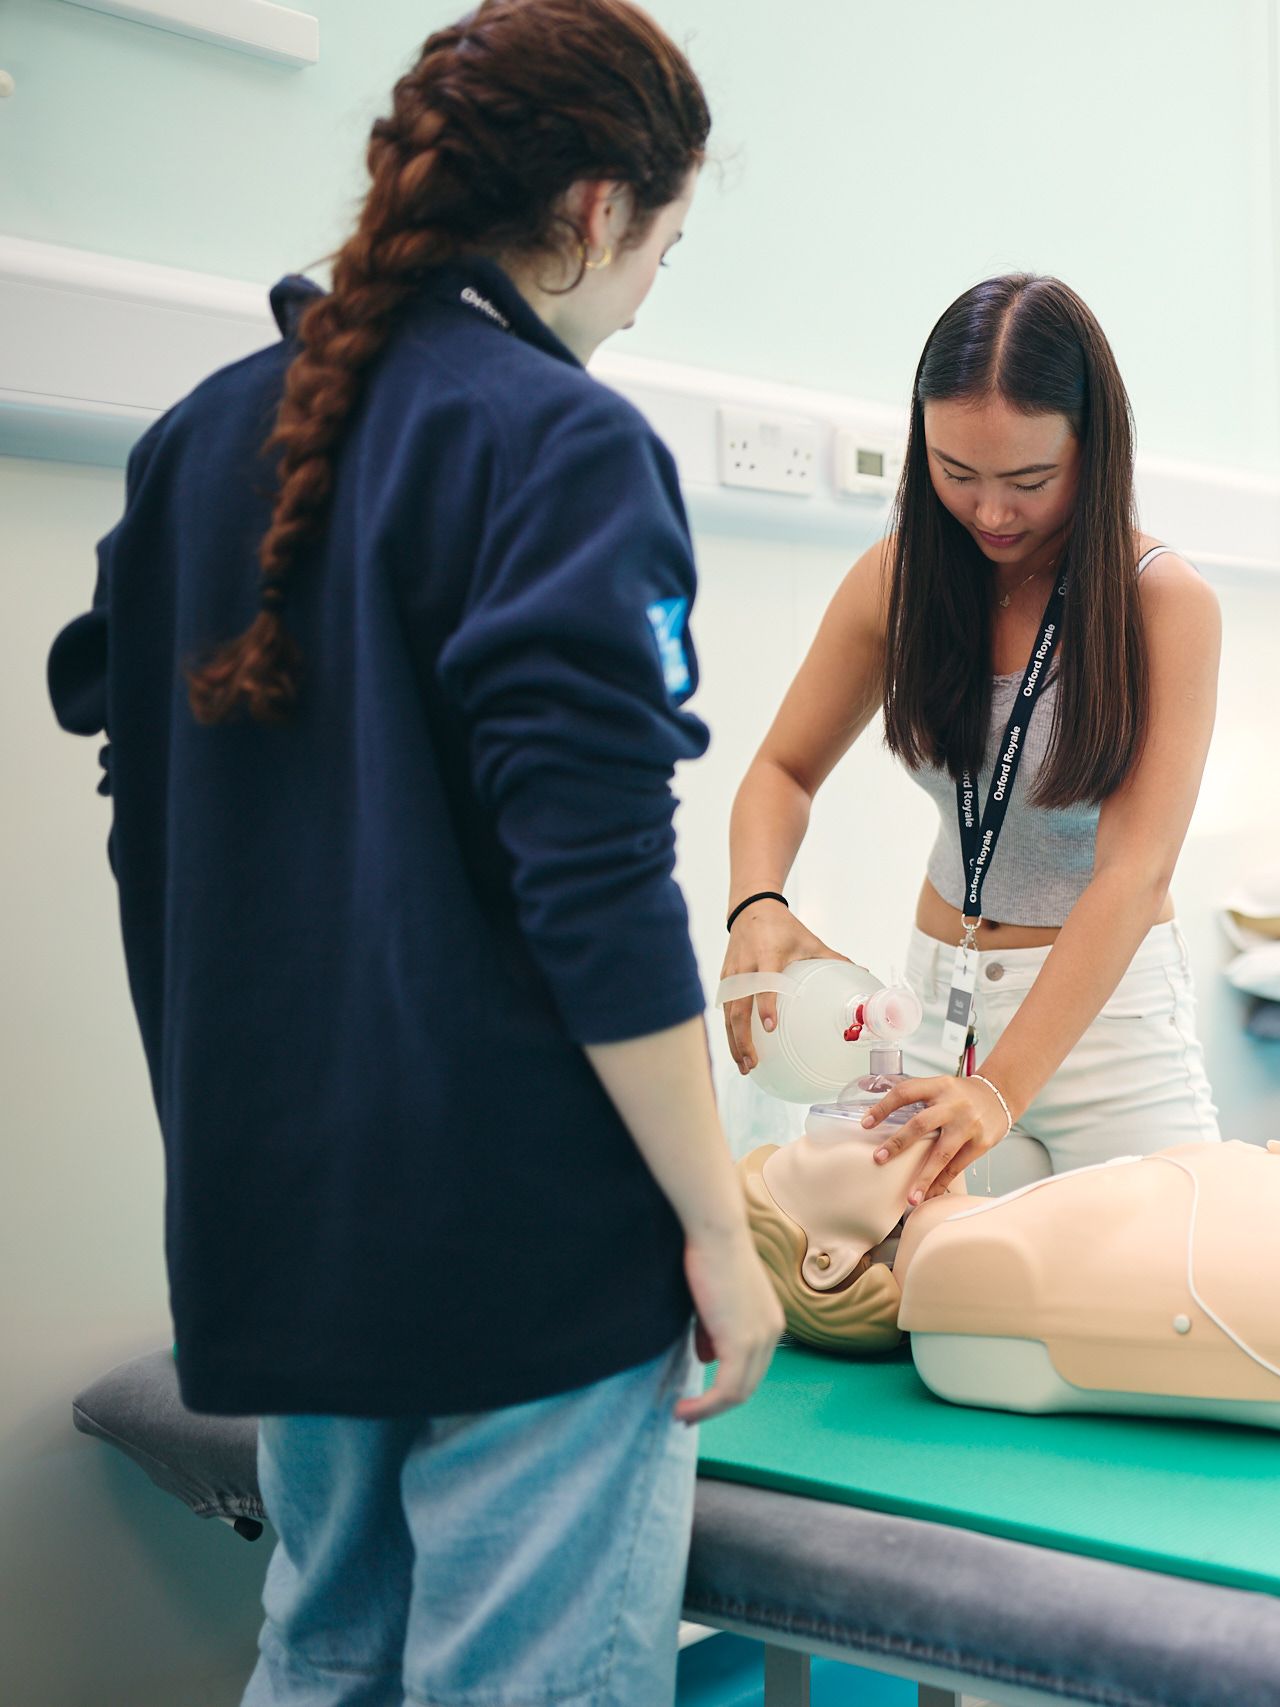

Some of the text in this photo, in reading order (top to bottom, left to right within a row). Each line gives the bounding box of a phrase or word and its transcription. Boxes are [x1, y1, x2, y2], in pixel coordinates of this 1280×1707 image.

[1023, 623, 1056, 697] Oxford Royale
[993, 725, 1021, 801] Oxford Royale
[962, 791, 975, 828] Royale
[969, 867, 982, 904] Oxford
[976, 829, 994, 866] Royale
